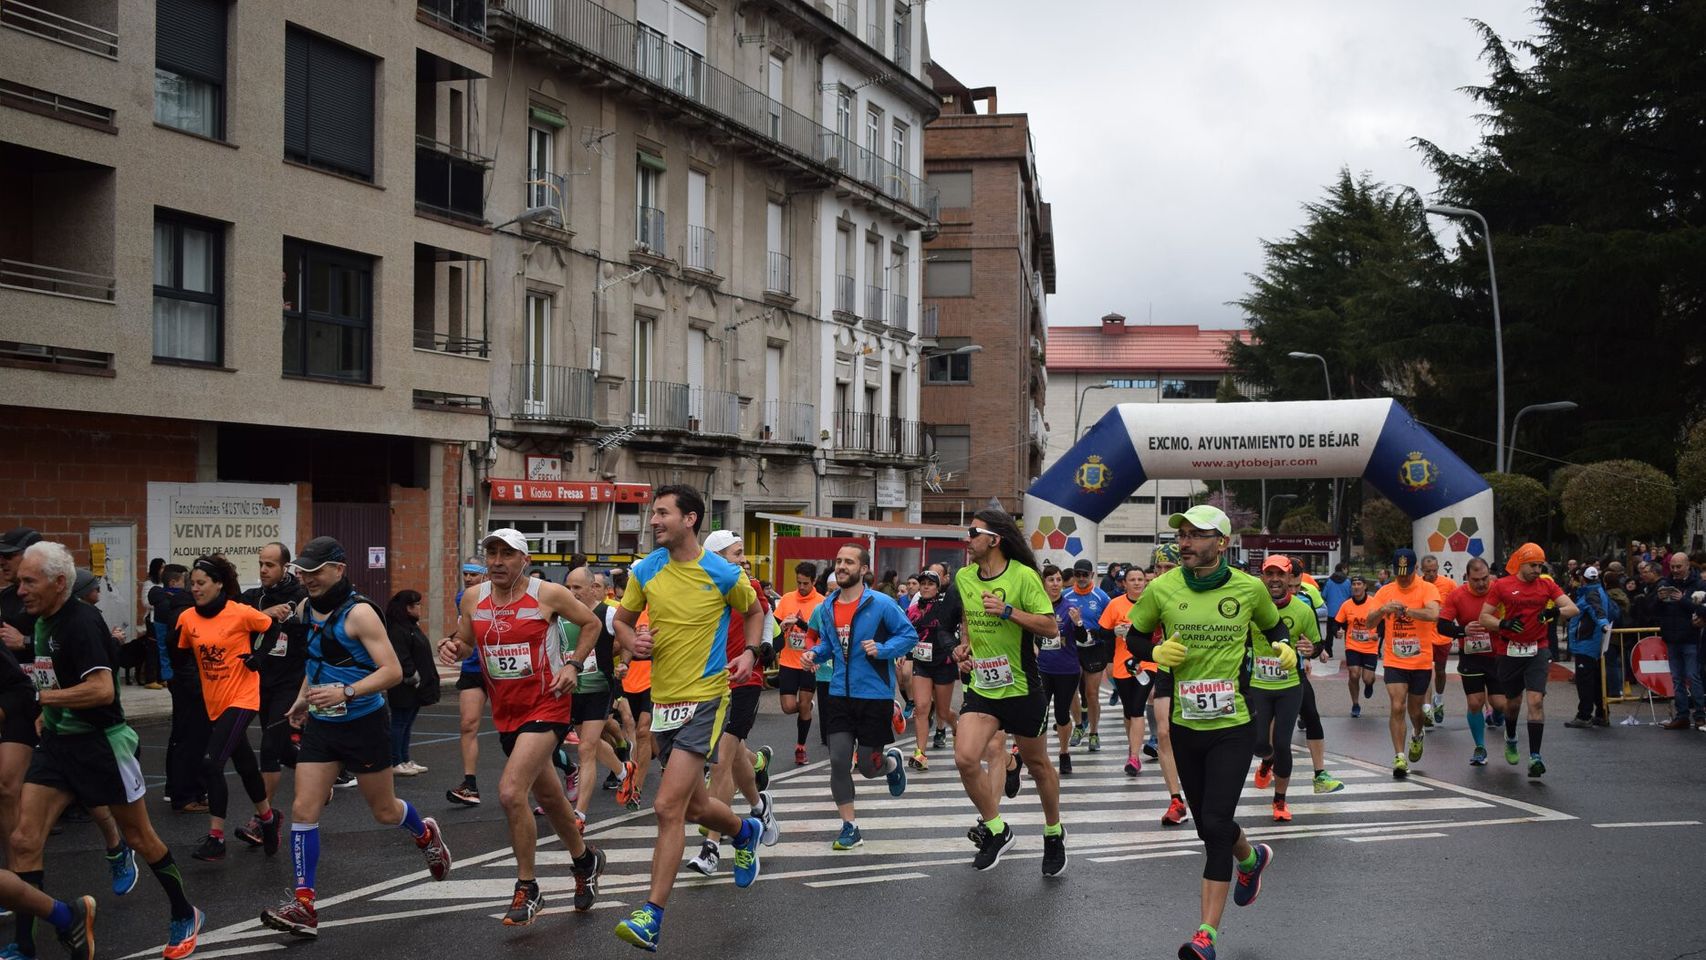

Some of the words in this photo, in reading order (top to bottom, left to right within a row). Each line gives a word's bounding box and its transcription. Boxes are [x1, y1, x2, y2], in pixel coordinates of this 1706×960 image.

[1149, 436, 1193, 450] EXCMO.
[1198, 435, 1295, 450] AYUNTAMIENTO
[1300, 434, 1315, 448] DE
[1319, 431, 1360, 447] BÉJAR
[1192, 457, 1318, 468] www.aytobejar.com
[530, 486, 553, 498] Kiosko
[558, 486, 584, 499] Fresas
[175, 524, 222, 538] VENTA
[225, 524, 242, 538] DE
[245, 524, 279, 538] PISOS
[173, 546, 211, 556] ALQUILER
[213, 546, 222, 554] DE
[224, 546, 264, 555] APARTAME
[1173, 623, 1242, 632] CORRECAMINOS
[1181, 633, 1234, 642] CARBAJOSA
[1401, 645, 1412, 653] 37
[1472, 641, 1482, 649] 21
[499, 657, 517, 671] 52
[983, 668, 1000, 681] 33
[1261, 665, 1281, 676] 110
[1197, 693, 1217, 710] 51
[663, 707, 689, 722] 103
